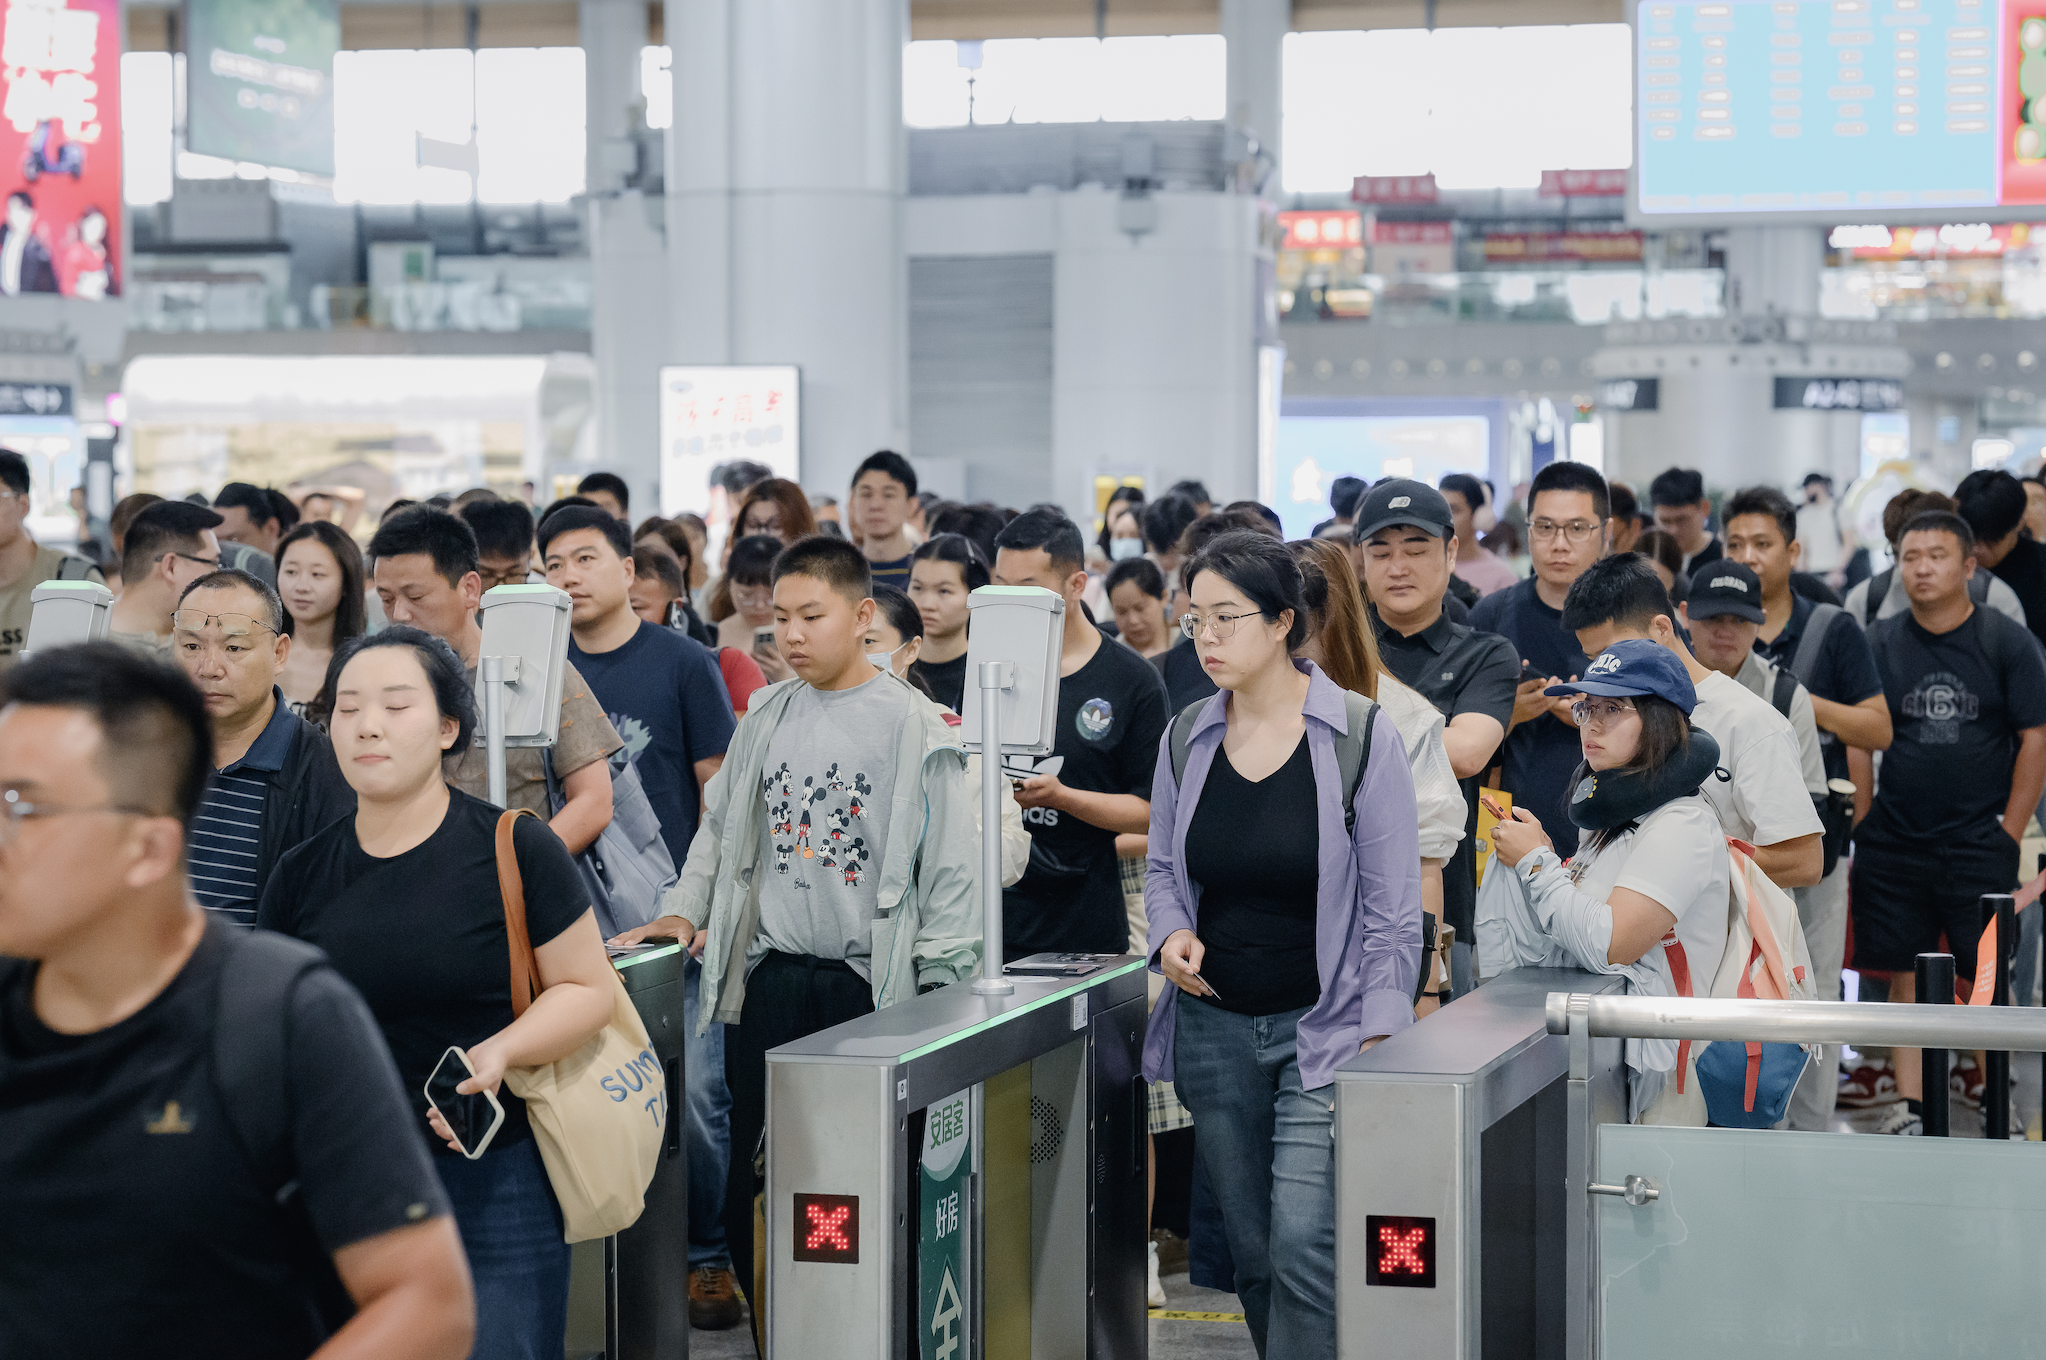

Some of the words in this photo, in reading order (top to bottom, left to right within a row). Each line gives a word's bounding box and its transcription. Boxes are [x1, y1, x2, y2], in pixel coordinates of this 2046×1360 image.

[1, 629, 22, 645] SS
[1022, 806, 1059, 827] as
[600, 1040, 662, 1102] SUM
[930, 1099, 964, 1150] 安居客
[936, 1190, 959, 1242] 好房
